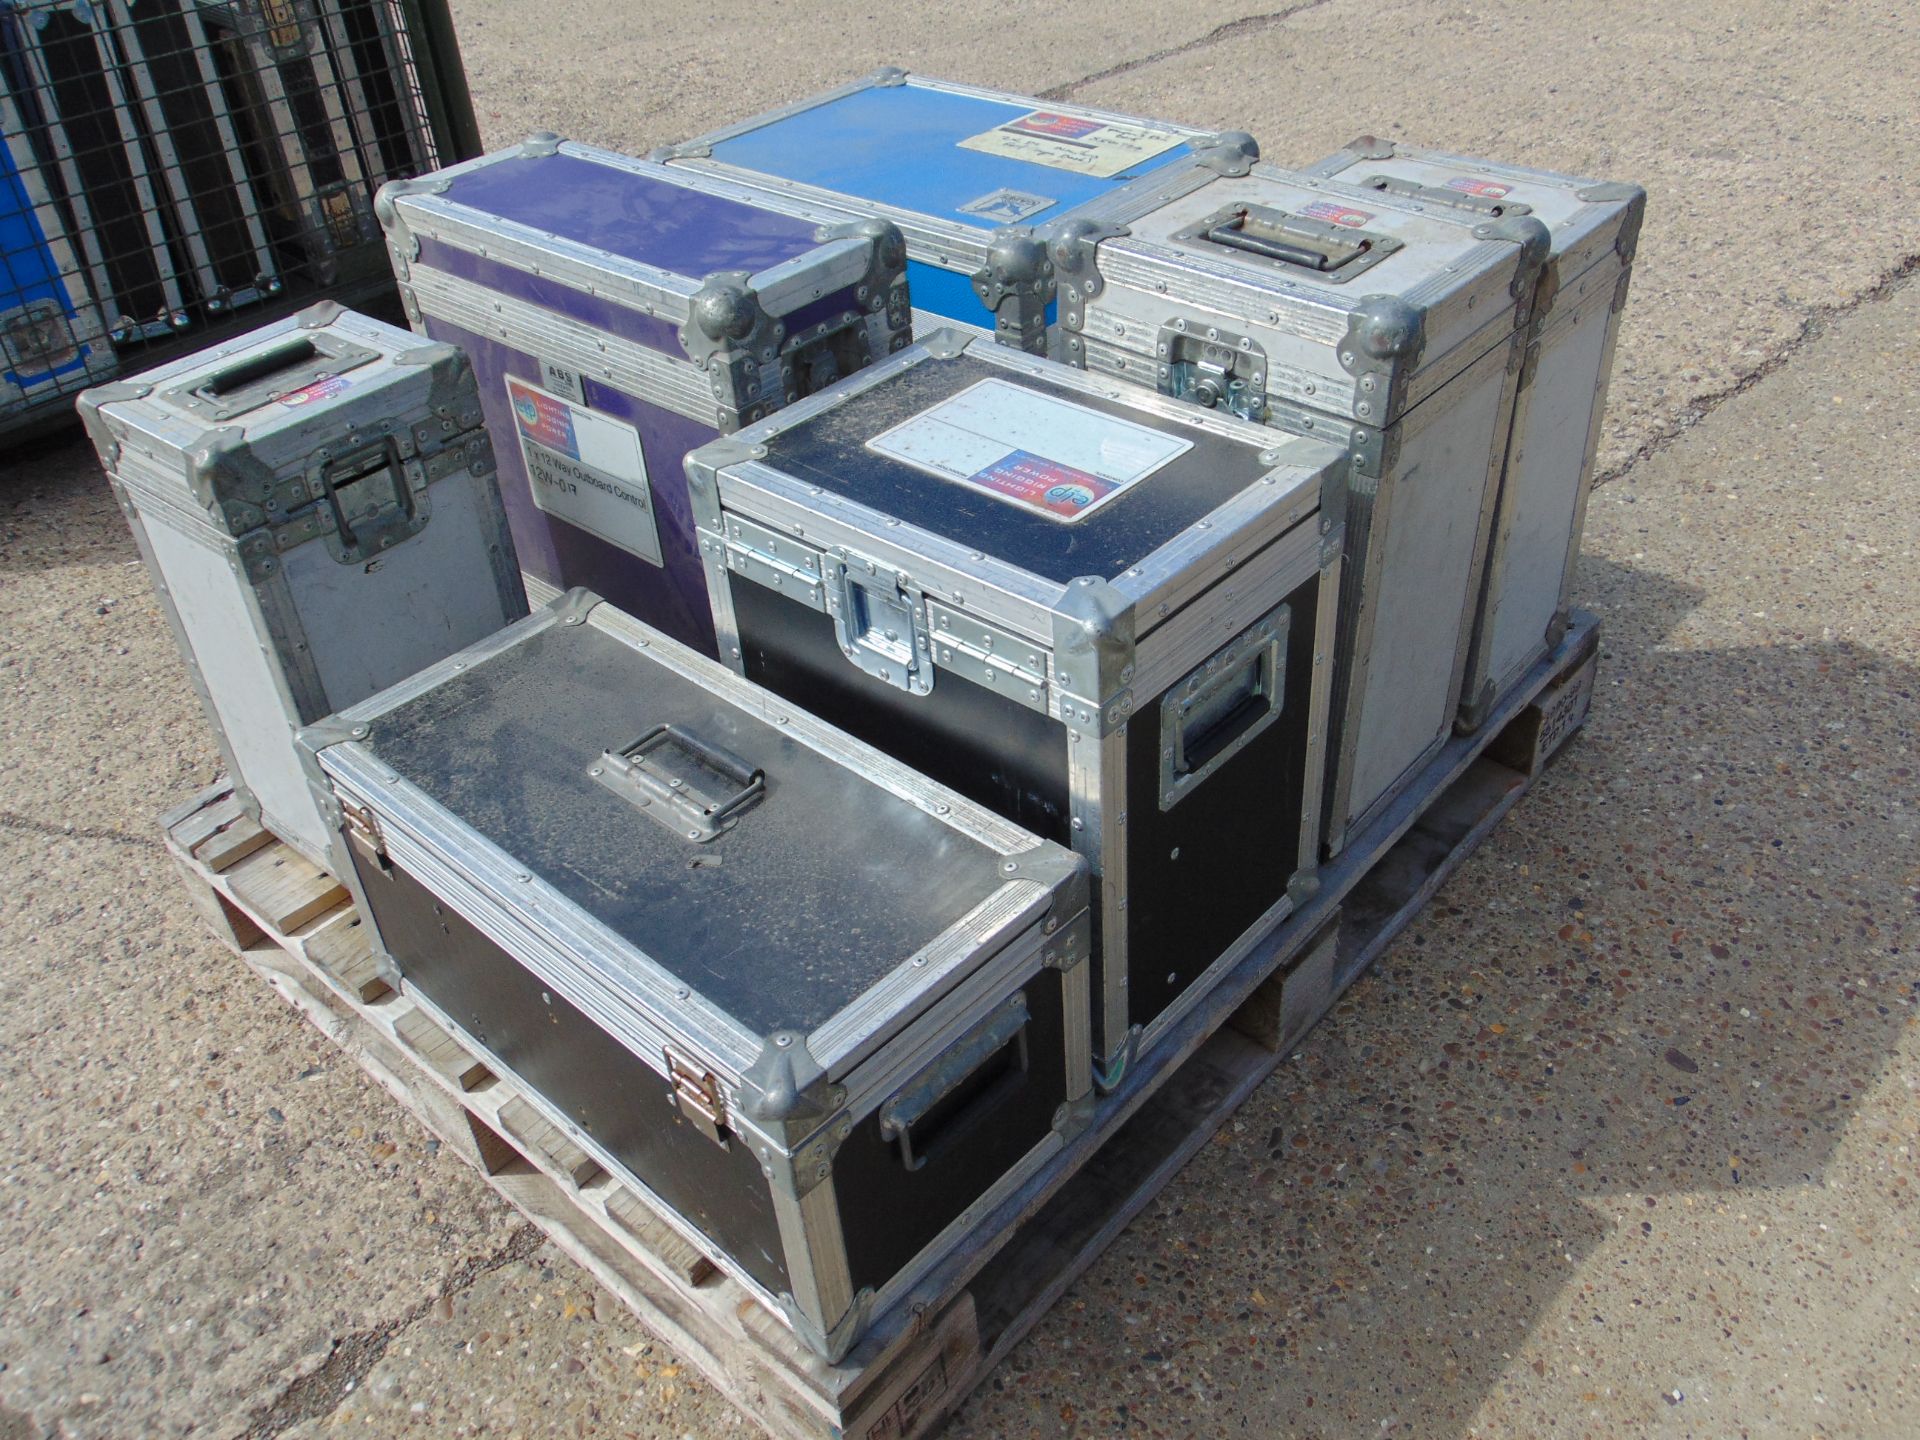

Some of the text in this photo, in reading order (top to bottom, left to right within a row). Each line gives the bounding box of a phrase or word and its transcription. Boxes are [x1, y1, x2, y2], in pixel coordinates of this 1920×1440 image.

[549, 366, 572, 382] ABS
[541, 452, 551, 467] 12
[554, 459, 572, 476] Way
[573, 467, 613, 494] Outboard
[614, 486, 646, 509] Control
[978, 472, 1036, 496] LIGHTING
[994, 467, 1047, 490] RIGGING
[1014, 465, 1058, 483] POWER
